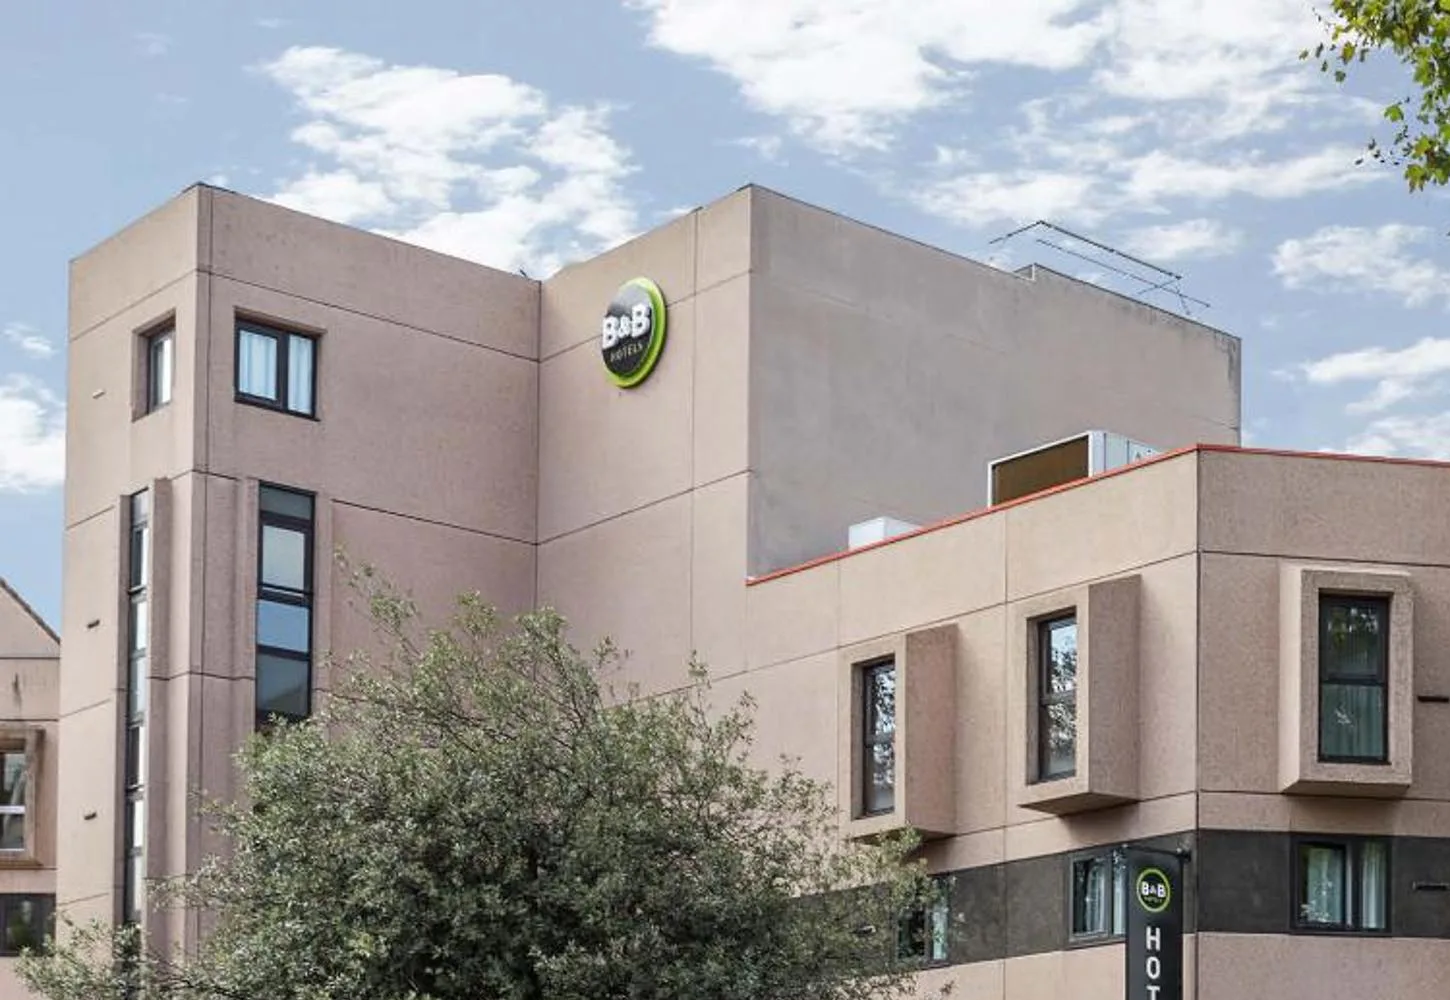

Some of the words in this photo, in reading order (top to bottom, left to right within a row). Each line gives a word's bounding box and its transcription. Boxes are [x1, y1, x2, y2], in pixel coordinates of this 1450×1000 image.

[602, 303, 651, 349] B&B
[610, 342, 643, 362] HOTELS
[1142, 881, 1166, 898] B&B
